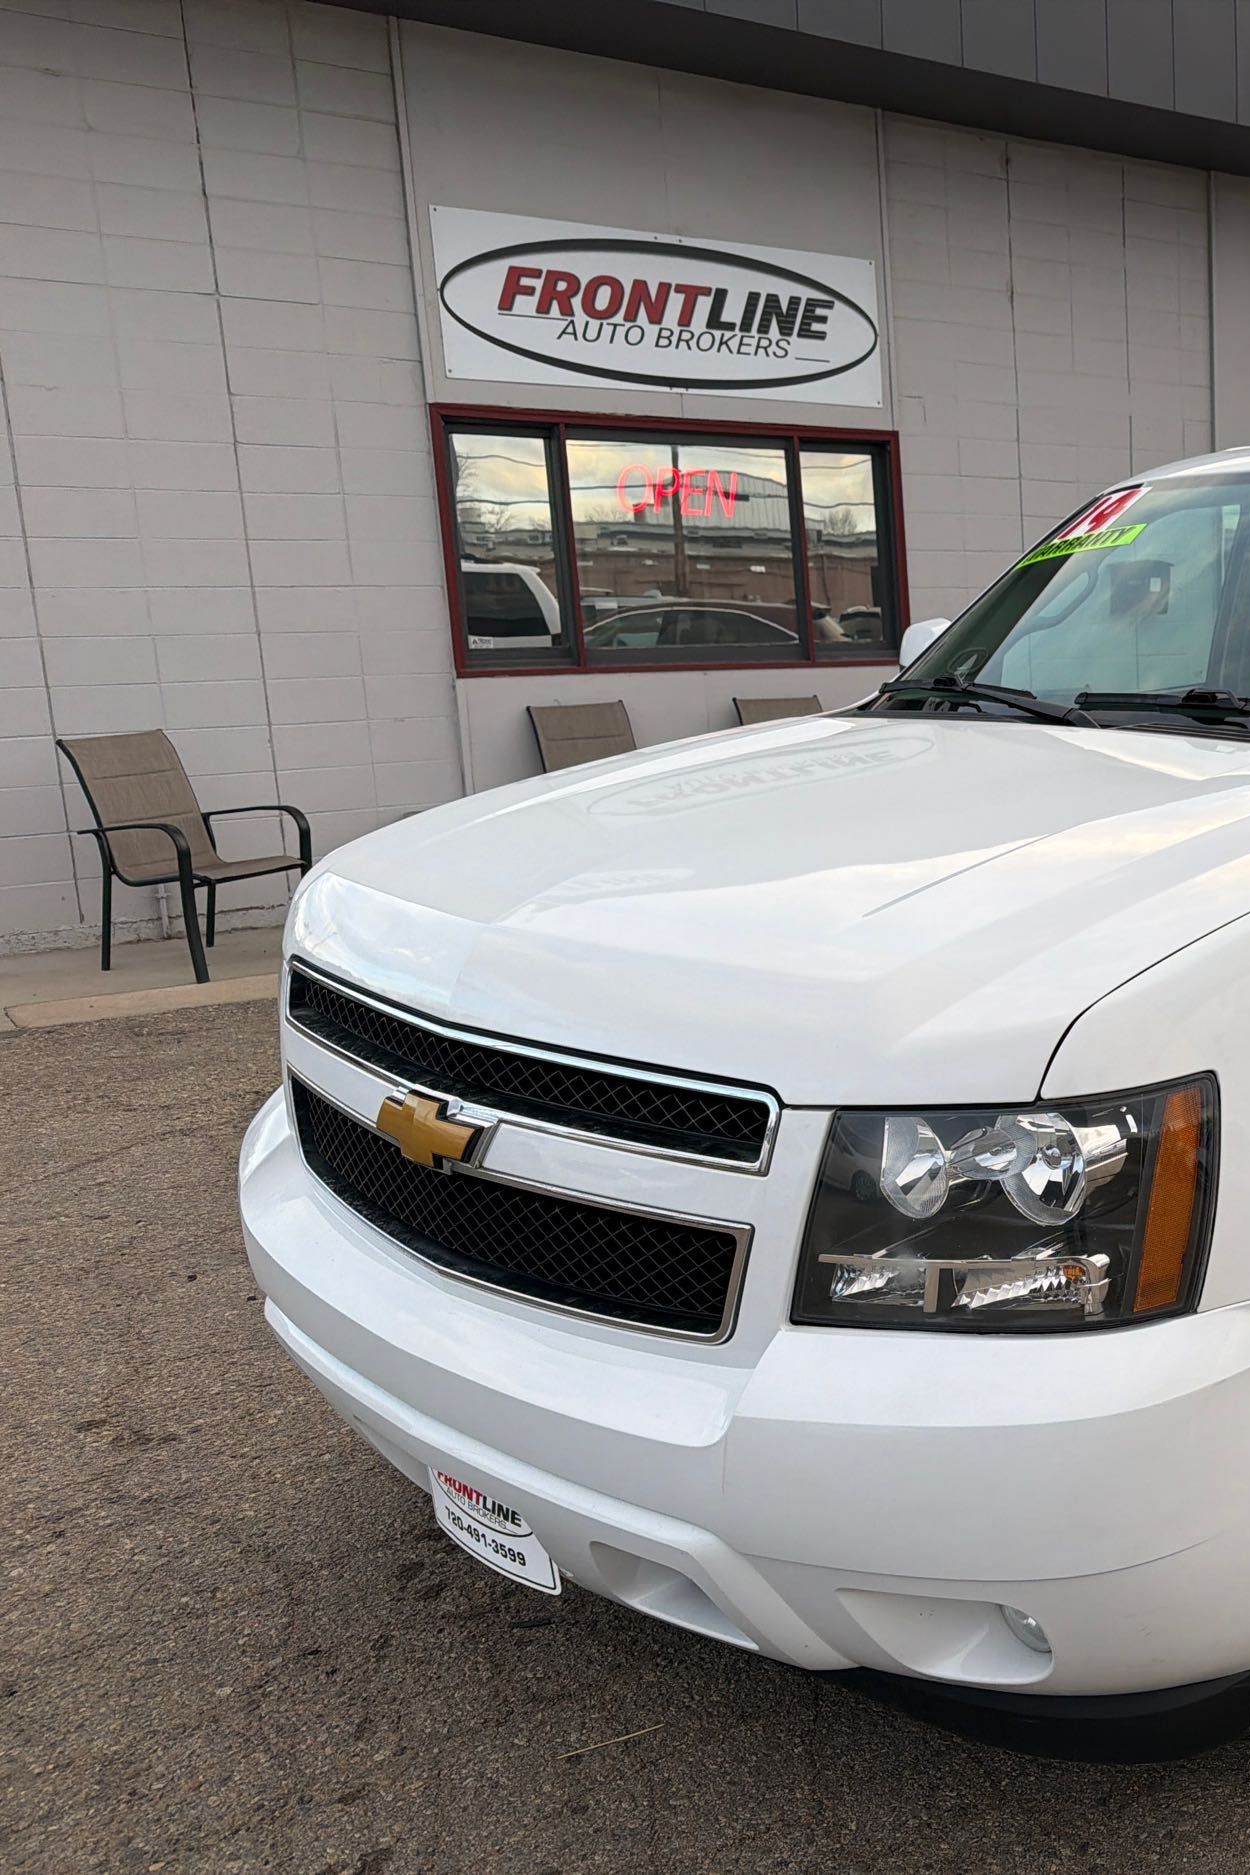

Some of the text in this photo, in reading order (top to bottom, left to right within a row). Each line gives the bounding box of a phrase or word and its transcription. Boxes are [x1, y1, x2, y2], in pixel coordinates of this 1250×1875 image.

[498, 266, 835, 340] FRONTLINE
[557, 319, 791, 359] AUTO BROKERS
[617, 464, 738, 518] OPEN
[447, 1487, 507, 1530] AUTO BROKERS
[444, 1505, 527, 1567] 720-491-3599
